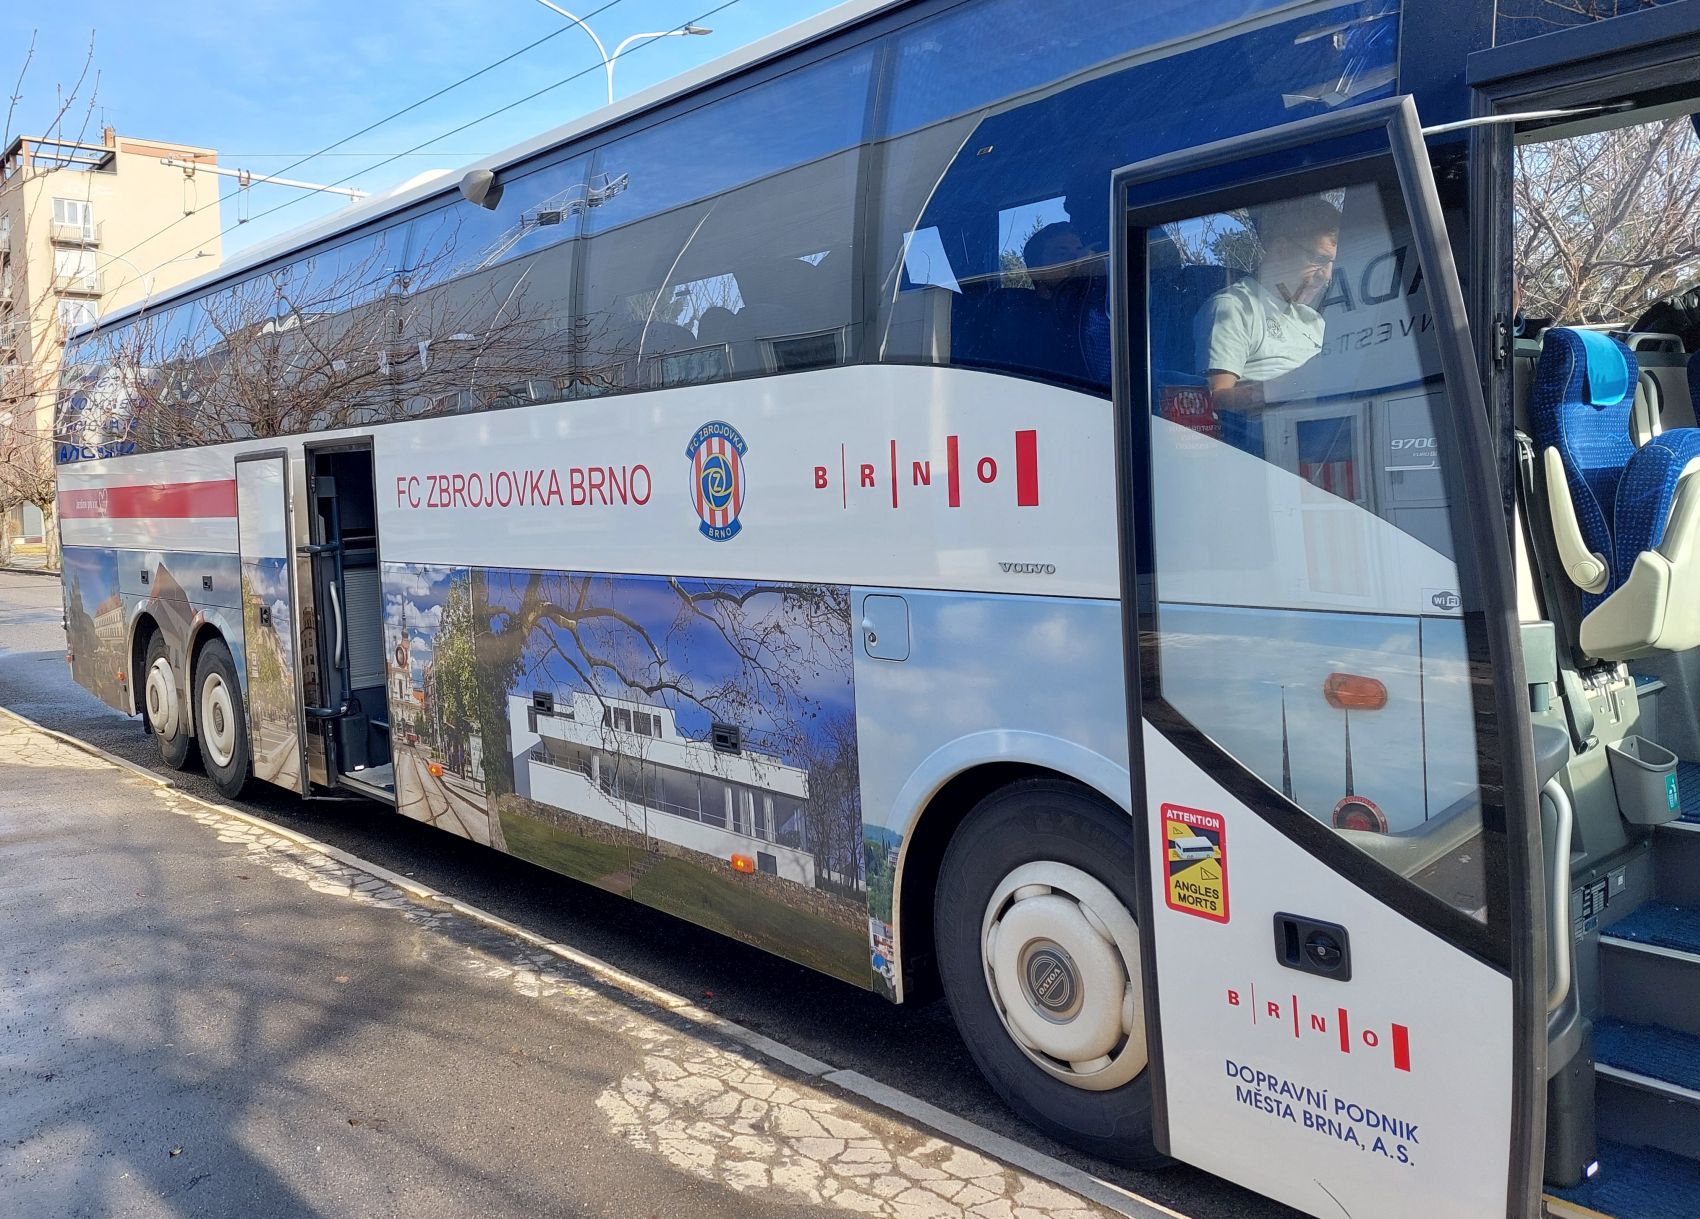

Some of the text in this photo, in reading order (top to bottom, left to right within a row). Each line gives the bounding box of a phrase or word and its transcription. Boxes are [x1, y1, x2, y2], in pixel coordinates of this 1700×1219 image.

[698, 423, 744, 452] ZBROJOVKA
[396, 464, 652, 508] FC ZBROJOVKA BRNO
[708, 527, 732, 539] BRNO
[999, 561, 1056, 575] VOLVO
[1166, 808, 1220, 829] ATTENTION
[1174, 879, 1220, 900] ANGLES
[1177, 892, 1217, 912] MORTS
[1038, 967, 1062, 995] VOLVO
[1226, 1059, 1420, 1144] DOPRAVNÍ PODNIK
[1235, 1085, 1415, 1167] MĚSTA BRNA, A.S.
